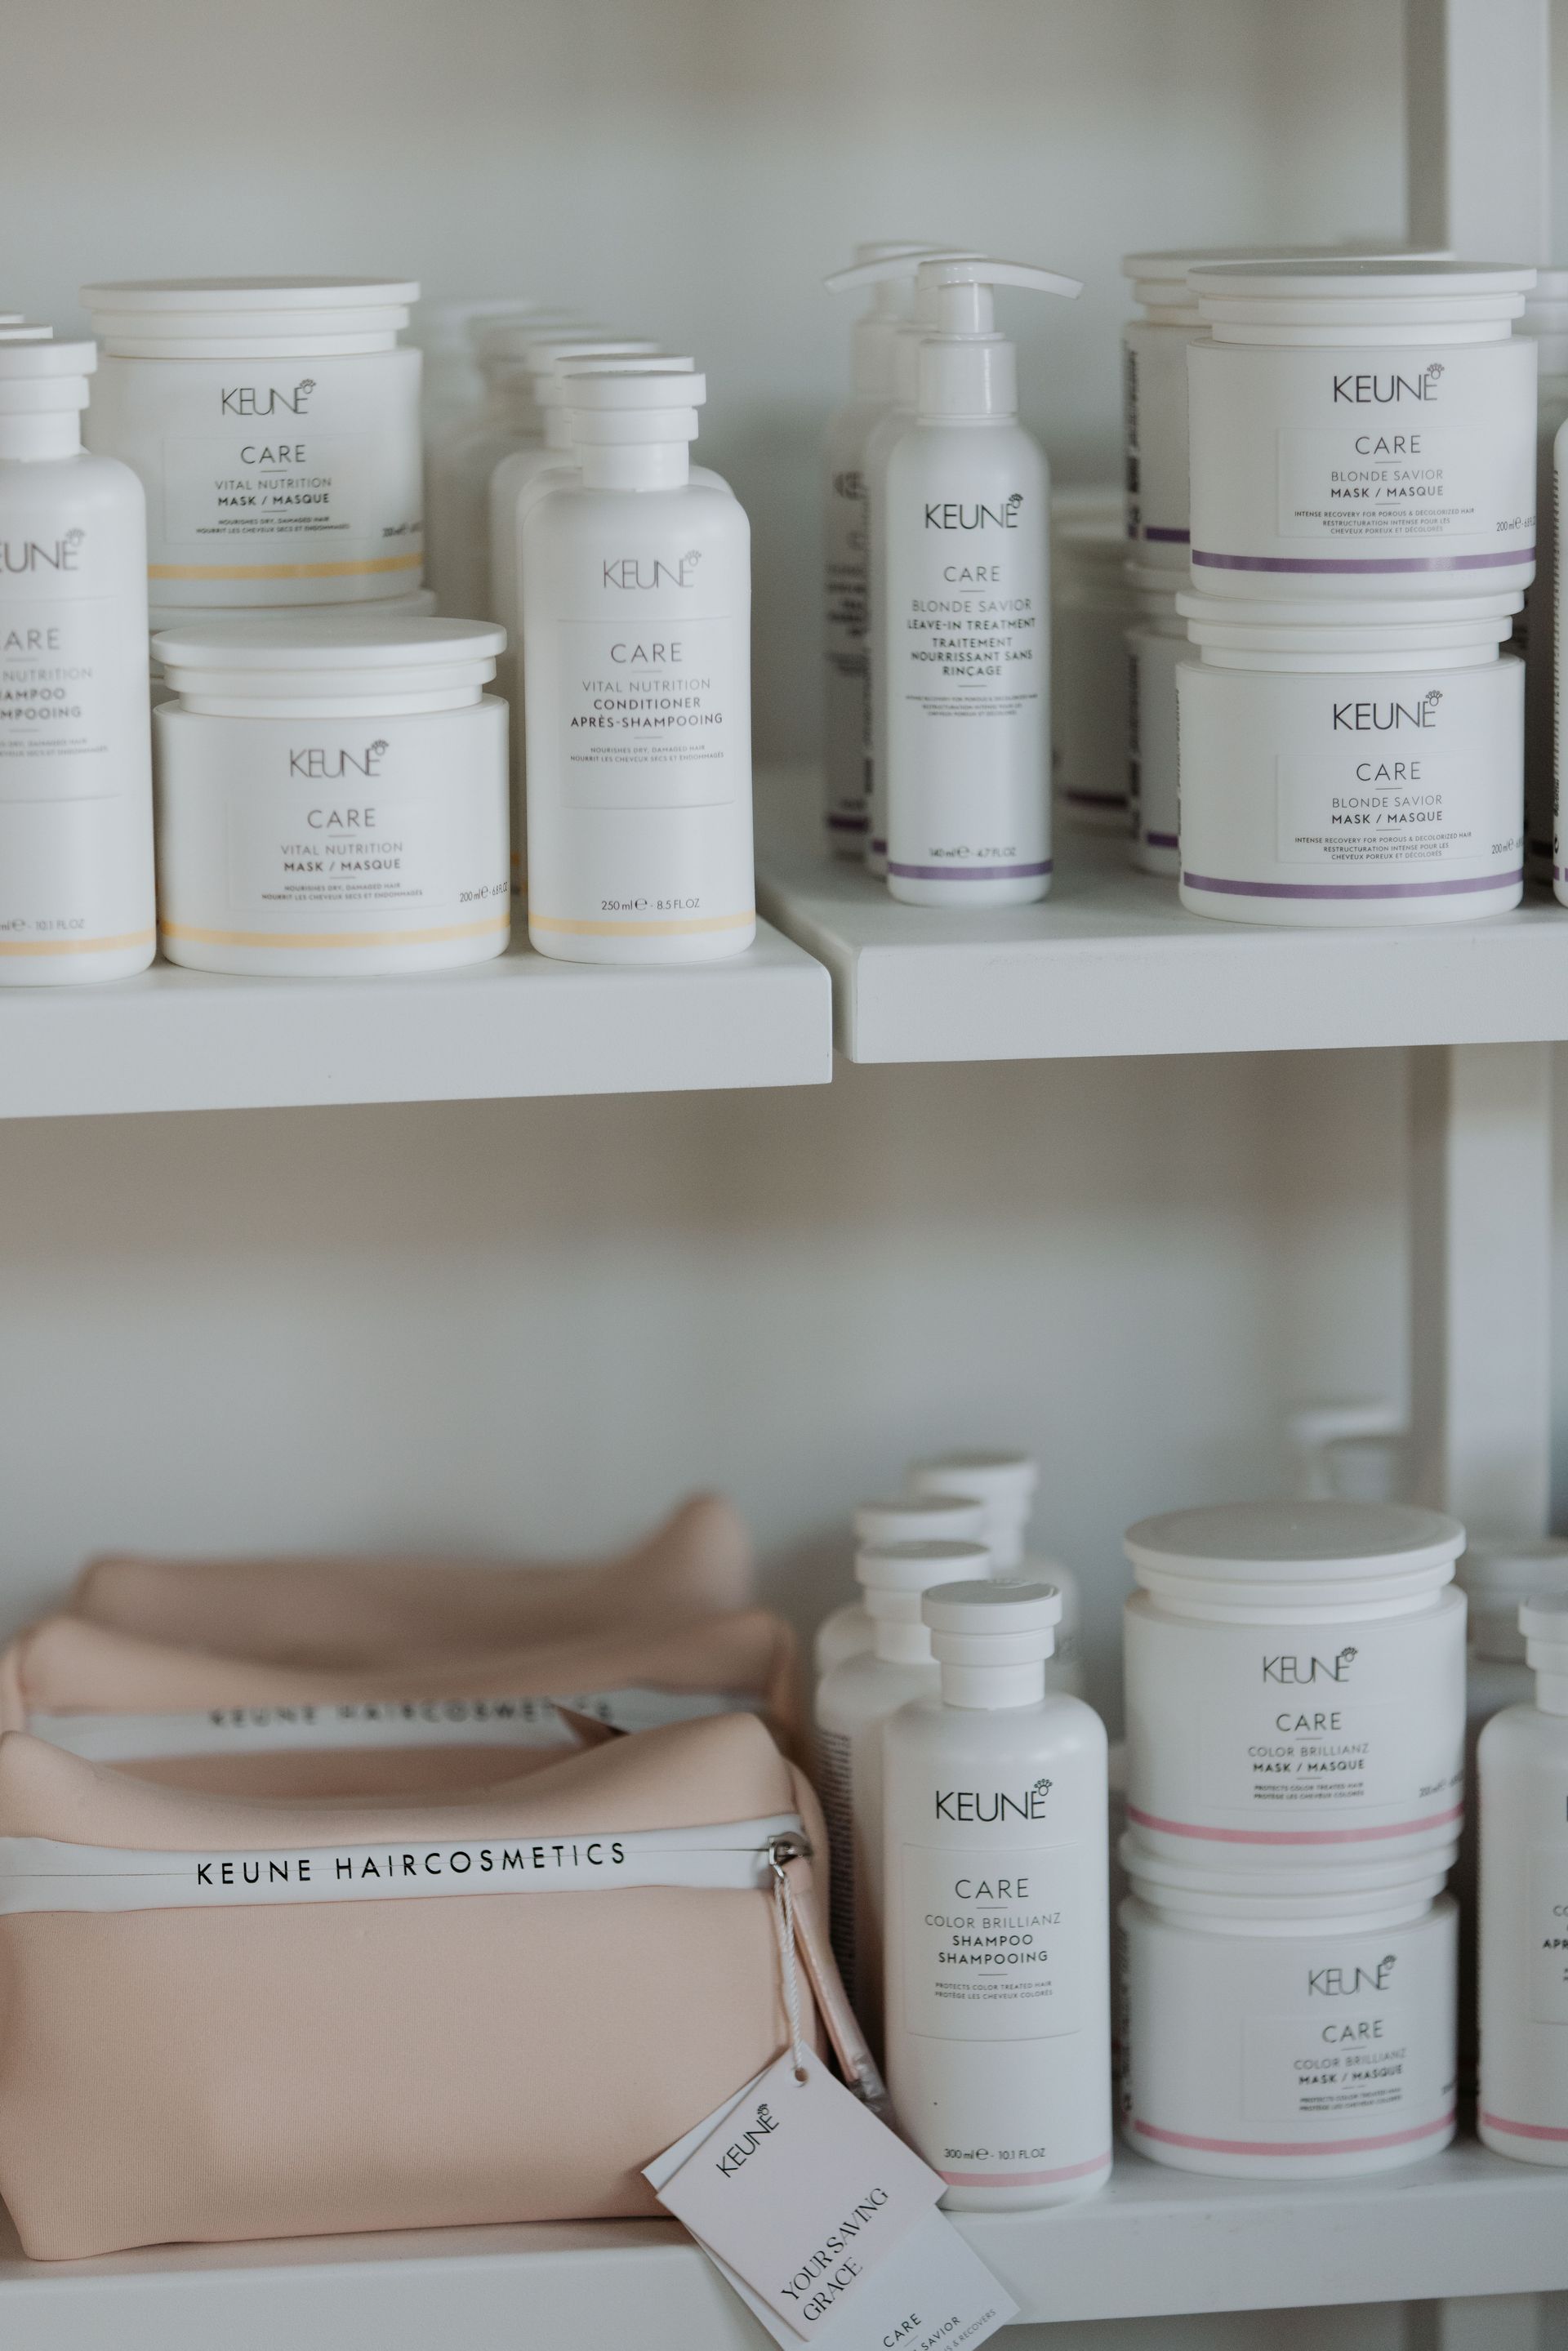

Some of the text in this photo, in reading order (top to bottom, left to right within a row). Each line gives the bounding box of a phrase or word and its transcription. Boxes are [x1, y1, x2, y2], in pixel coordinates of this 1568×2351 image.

[1334, 370, 1441, 403] KEUNE
[222, 384, 313, 416] KEUNE
[1356, 435, 1421, 455] CARE
[240, 444, 306, 465] CARE
[215, 477, 332, 491] VITAL NUTRITION
[1331, 469, 1443, 483] BLONDE SAVIOR
[218, 493, 330, 506] MASK / MASQUE
[1330, 485, 1444, 498] MASK / MASQUE
[925, 499, 1021, 530] KEUNE
[0, 540, 79, 573] UNE
[604, 554, 697, 590] KEUNE
[943, 566, 1001, 582] CARE
[911, 598, 1032, 613] BLONDE SAVIOR
[906, 617, 1036, 630] LEAVE-IN TREATMENT
[0, 628, 61, 651] ARE
[932, 637, 1013, 648] TRAITEMENT
[610, 642, 683, 664] CARE
[911, 649, 1033, 662] NOURRISSANT SANS
[942, 665, 1002, 677] RINÇAGE
[582, 678, 711, 693] VITAL NUTRITION
[0, 687, 66, 701] AMPOO
[593, 697, 701, 710] CONDITIONER
[0, 706, 82, 721] MPOOING
[570, 712, 723, 728] APRÈS-SHAMPOOING
[1334, 697, 1439, 730] KEUNE
[590, 746, 631, 755] NOURISHES
[652, 746, 688, 754] DAMAGED
[290, 743, 384, 778] KEUNE
[1356, 761, 1421, 781] CARE
[1332, 795, 1442, 809] BLONDE SAVIOR
[307, 808, 376, 829] CARE
[1332, 811, 1443, 825] MASK / MASQUE
[281, 842, 403, 856] VITAL NUTRITION
[284, 859, 401, 872] MASK / MASQUE
[345, 883, 382, 891] DAMAGED
[601, 900, 620, 911] 250
[657, 899, 671, 911] 8.5
[1263, 1651, 1353, 1684] KEUNE
[1276, 1712, 1342, 1732] CARE
[1248, 1743, 1370, 1757] COLOR BRILLIANZ
[1253, 1759, 1365, 1773] MASK / MASQUE
[936, 1785, 1049, 1822] KEUNE
[198, 1842, 626, 1886] KEUNE HAIRCOSMETICS
[955, 1878, 1029, 1899] CARE
[924, 1912, 1061, 1929] COLOR BRILLIANZ
[952, 1934, 1033, 1947] SHAMPOO
[938, 1951, 1048, 1965] SHAMPOOING
[1308, 1959, 1393, 1996] KEUNE
[935, 1982, 970, 1990] PROTECTS
[1322, 2019, 1384, 2043] CARE
[1294, 2058, 1340, 2071] COLOR
[1298, 2073, 1337, 2086] MASK
[1352, 2064, 1404, 2081] MASQUE
[715, 2108, 779, 2178] KEUNE
[944, 2148, 962, 2158] 300
[781, 2187, 889, 2300] YOUR SAVING
[802, 2256, 863, 2322] GRACE
[883, 2313, 922, 2348] CARE
[921, 2316, 961, 2351] SAVIOR
[958, 2309, 997, 2342] RECOVERS
